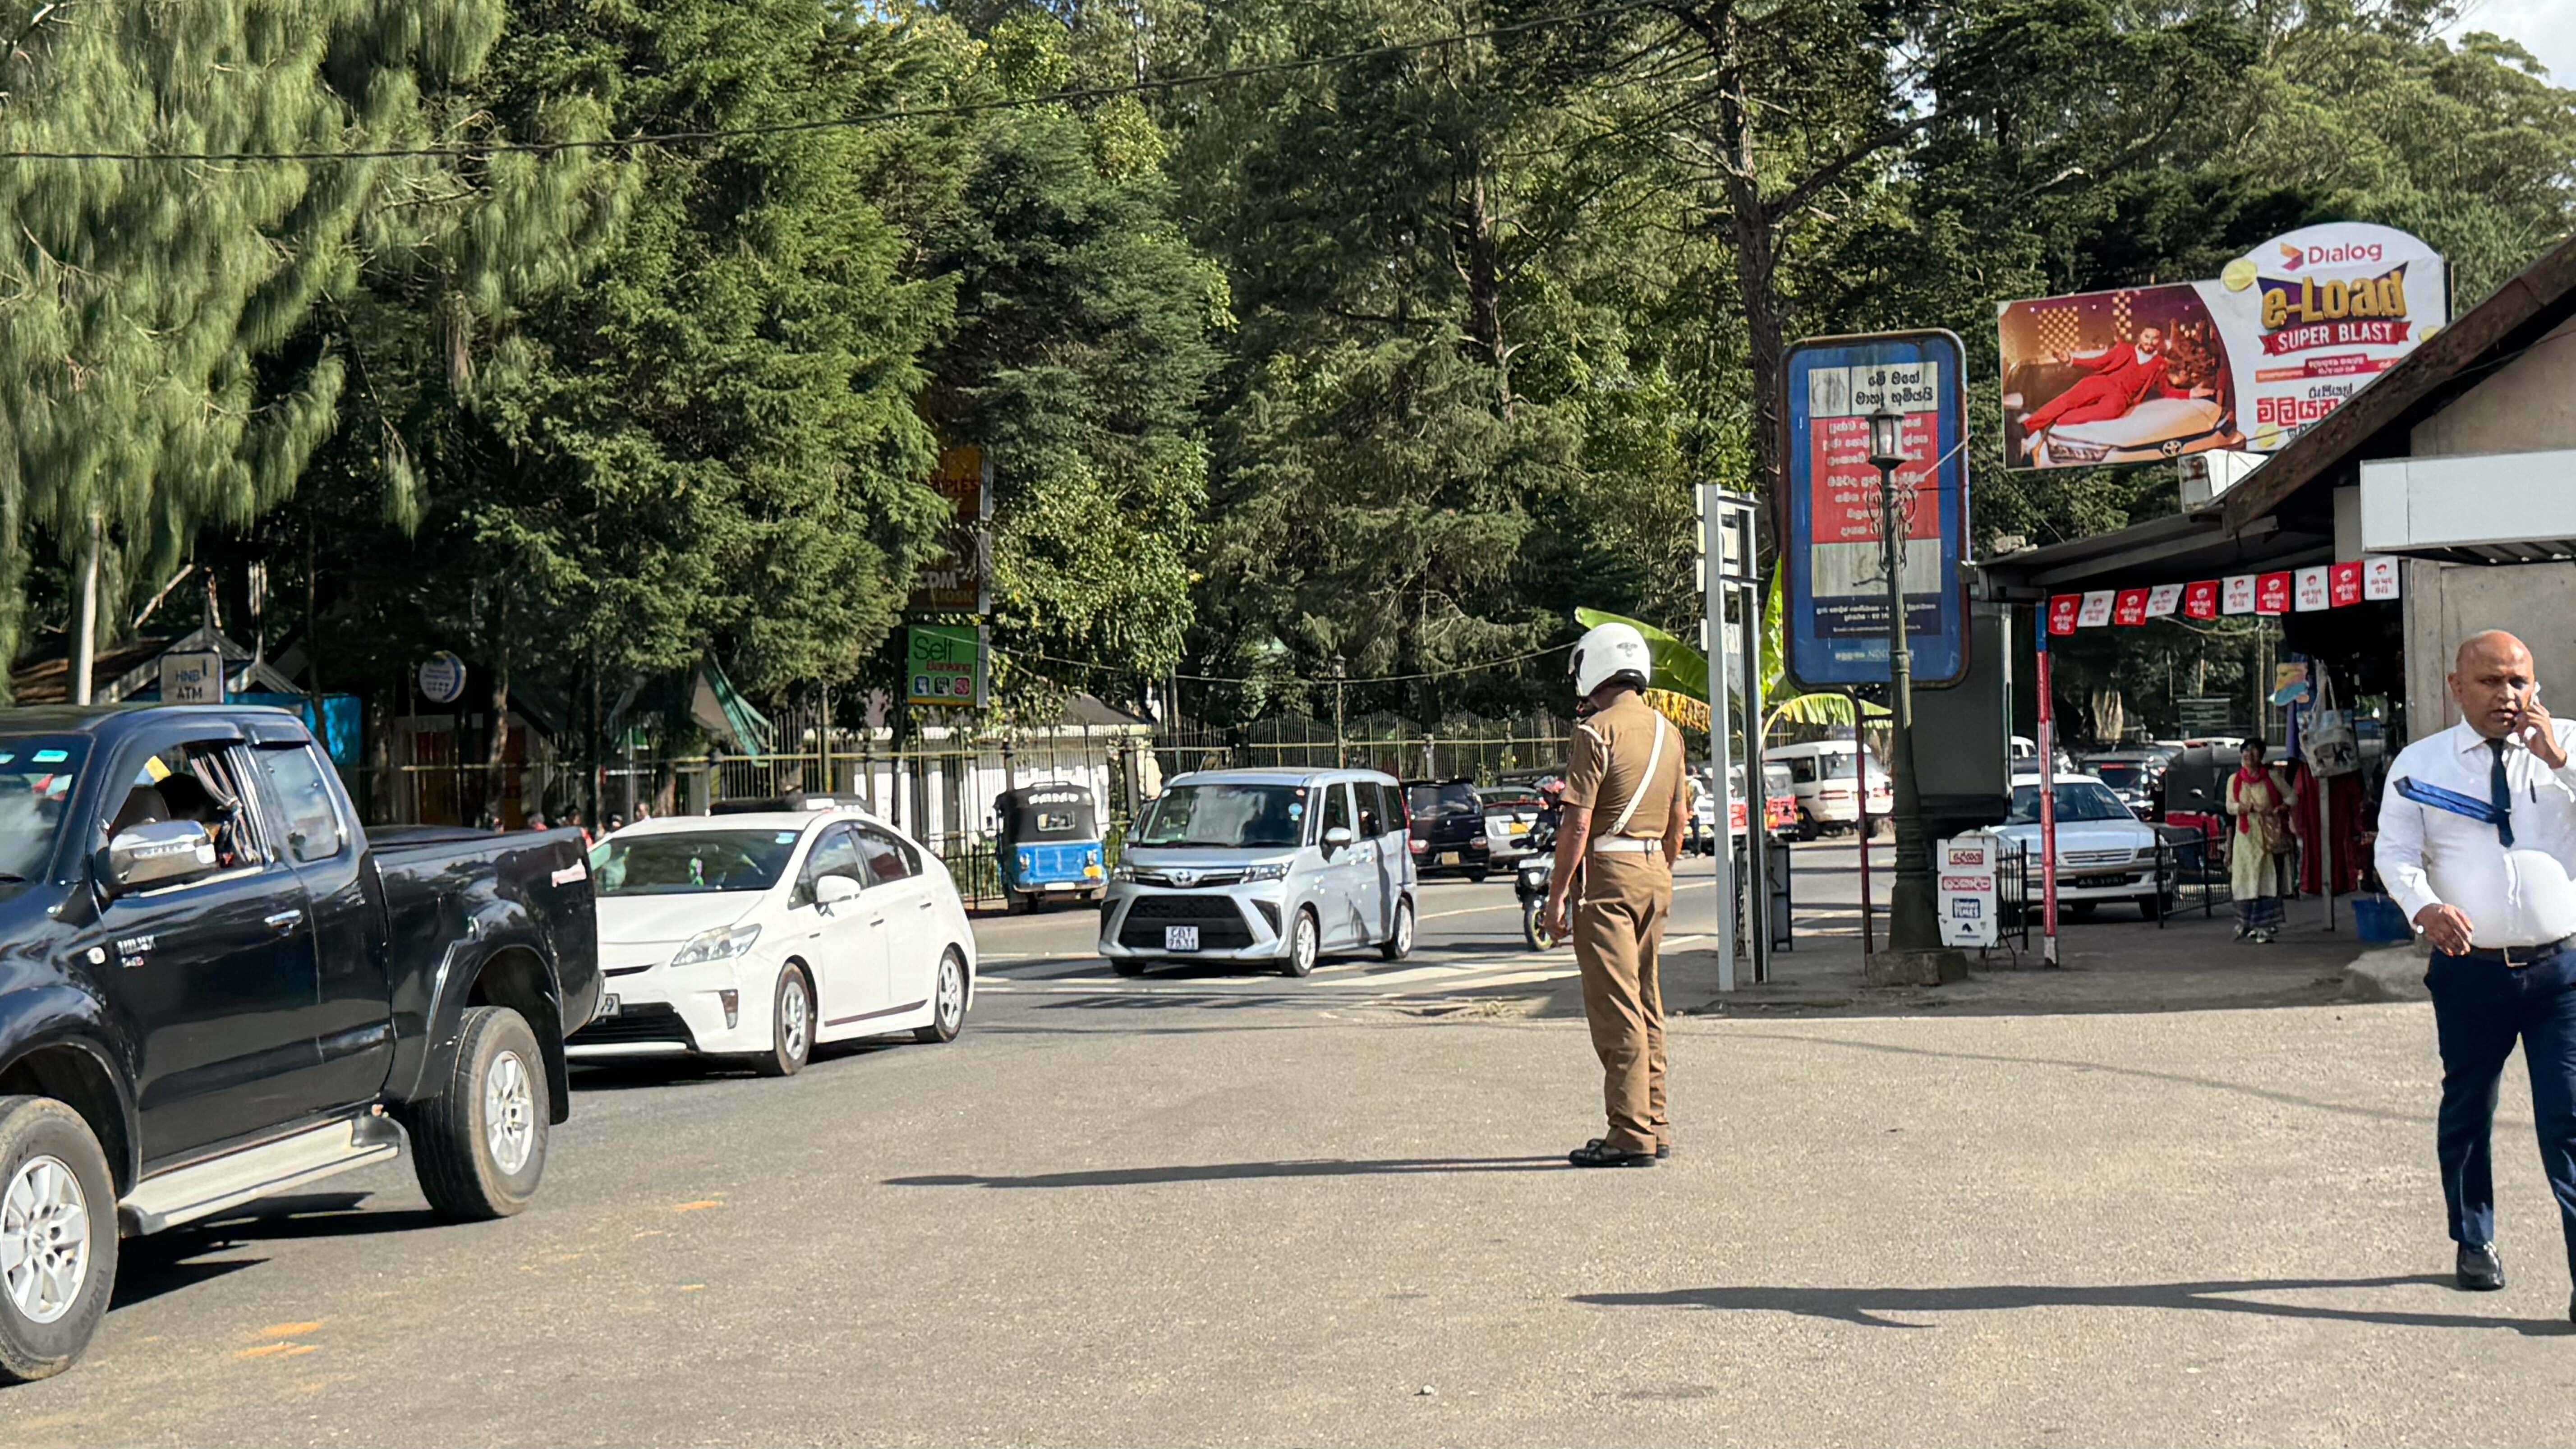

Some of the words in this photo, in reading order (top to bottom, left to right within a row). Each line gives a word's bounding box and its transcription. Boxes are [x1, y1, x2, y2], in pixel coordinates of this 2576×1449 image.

[2309, 243, 2383, 264] Dialog
[2261, 270, 2407, 329] e-Load
[2277, 324, 2330, 352] SUPER
[2338, 322, 2393, 343] BLAST
[913, 635, 955, 664] Self
[177, 686, 202, 699] ATM
